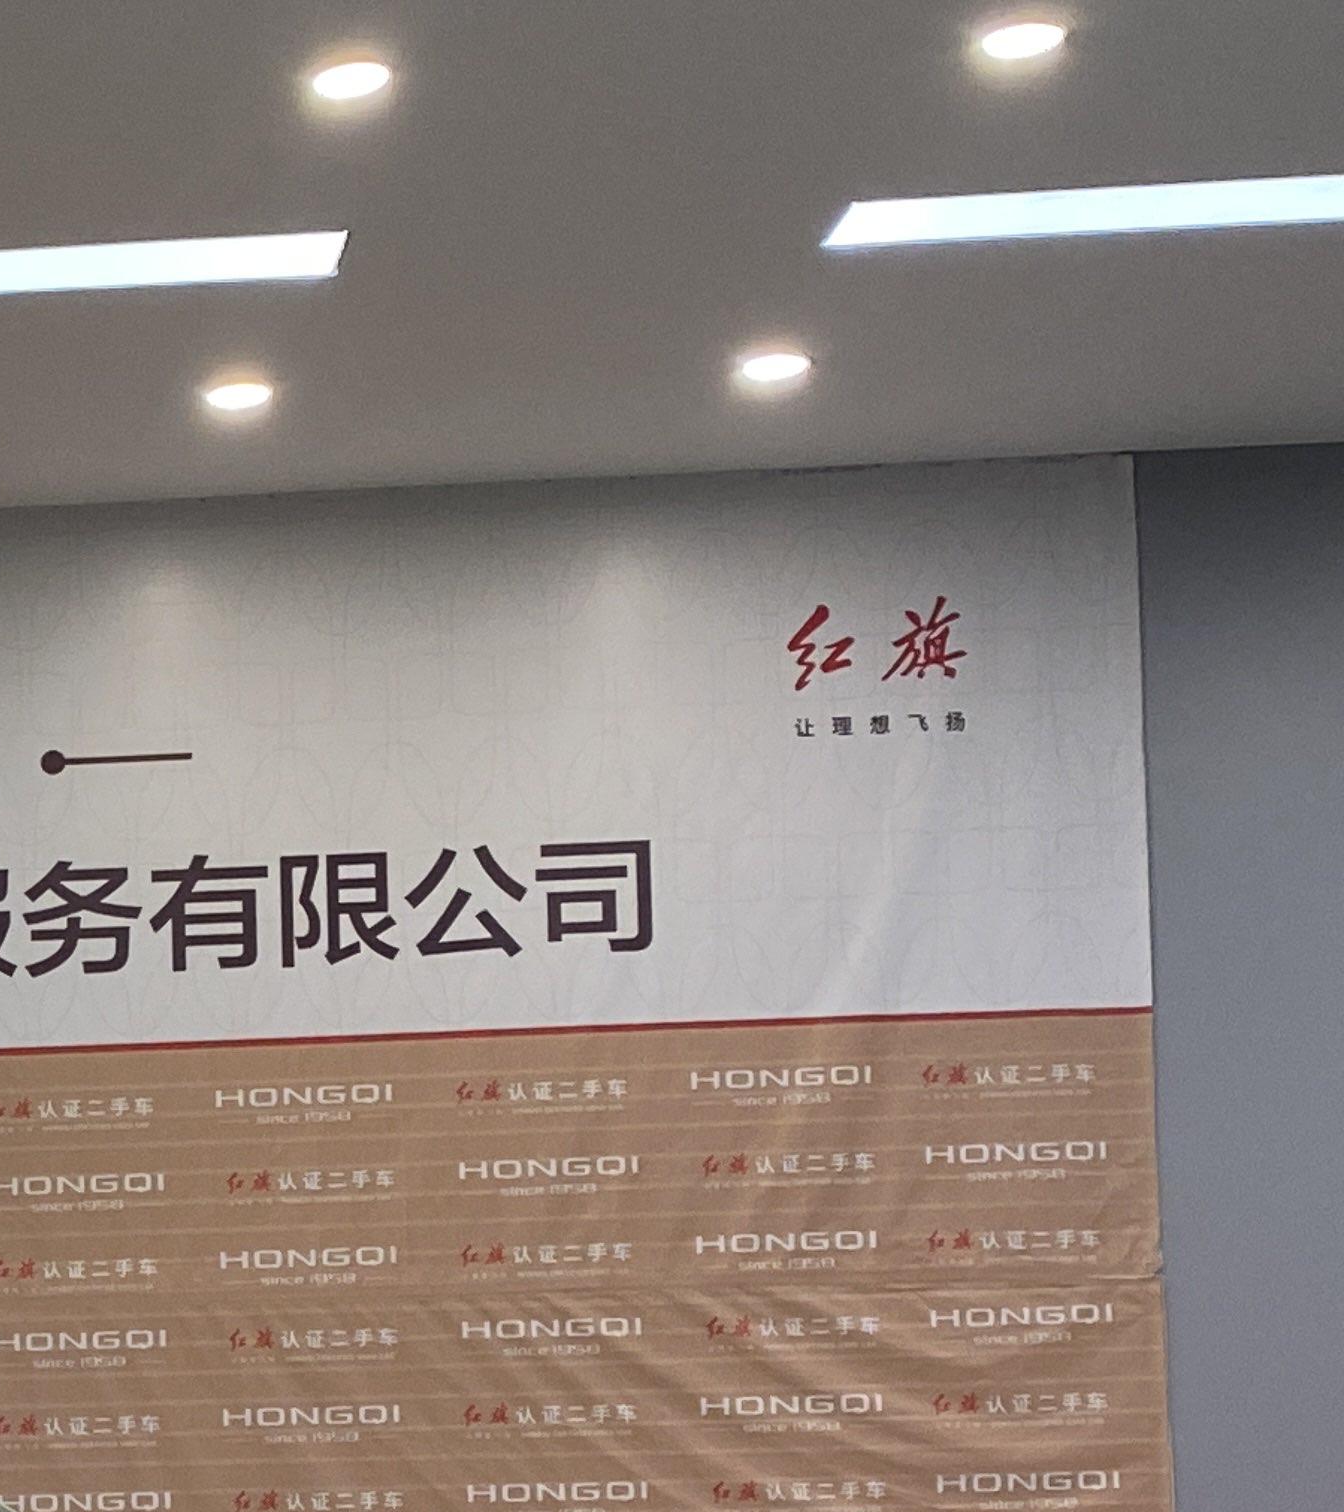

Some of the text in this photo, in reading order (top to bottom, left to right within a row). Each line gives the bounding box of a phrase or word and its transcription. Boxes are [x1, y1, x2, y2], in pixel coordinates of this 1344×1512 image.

[787, 596, 968, 691] 红旗
[794, 711, 966, 738] 让理想飞扬
[691, 1066, 871, 1090] HONGQI
[216, 1084, 392, 1107] HONGQI
[925, 1141, 1106, 1164] HONGQI
[459, 1155, 638, 1179] HONGQI
[696, 1230, 876, 1254] HONGQI
[220, 1246, 397, 1269] HONGQI
[928, 1303, 1112, 1327] HONGQI
[462, 1317, 641, 1339] HONGQI
[701, 1392, 882, 1415] HONGQI
[223, 1405, 400, 1426] HONGQI
[467, 1481, 647, 1503] HONGQI
[937, 1470, 1120, 1493] HONGQI
